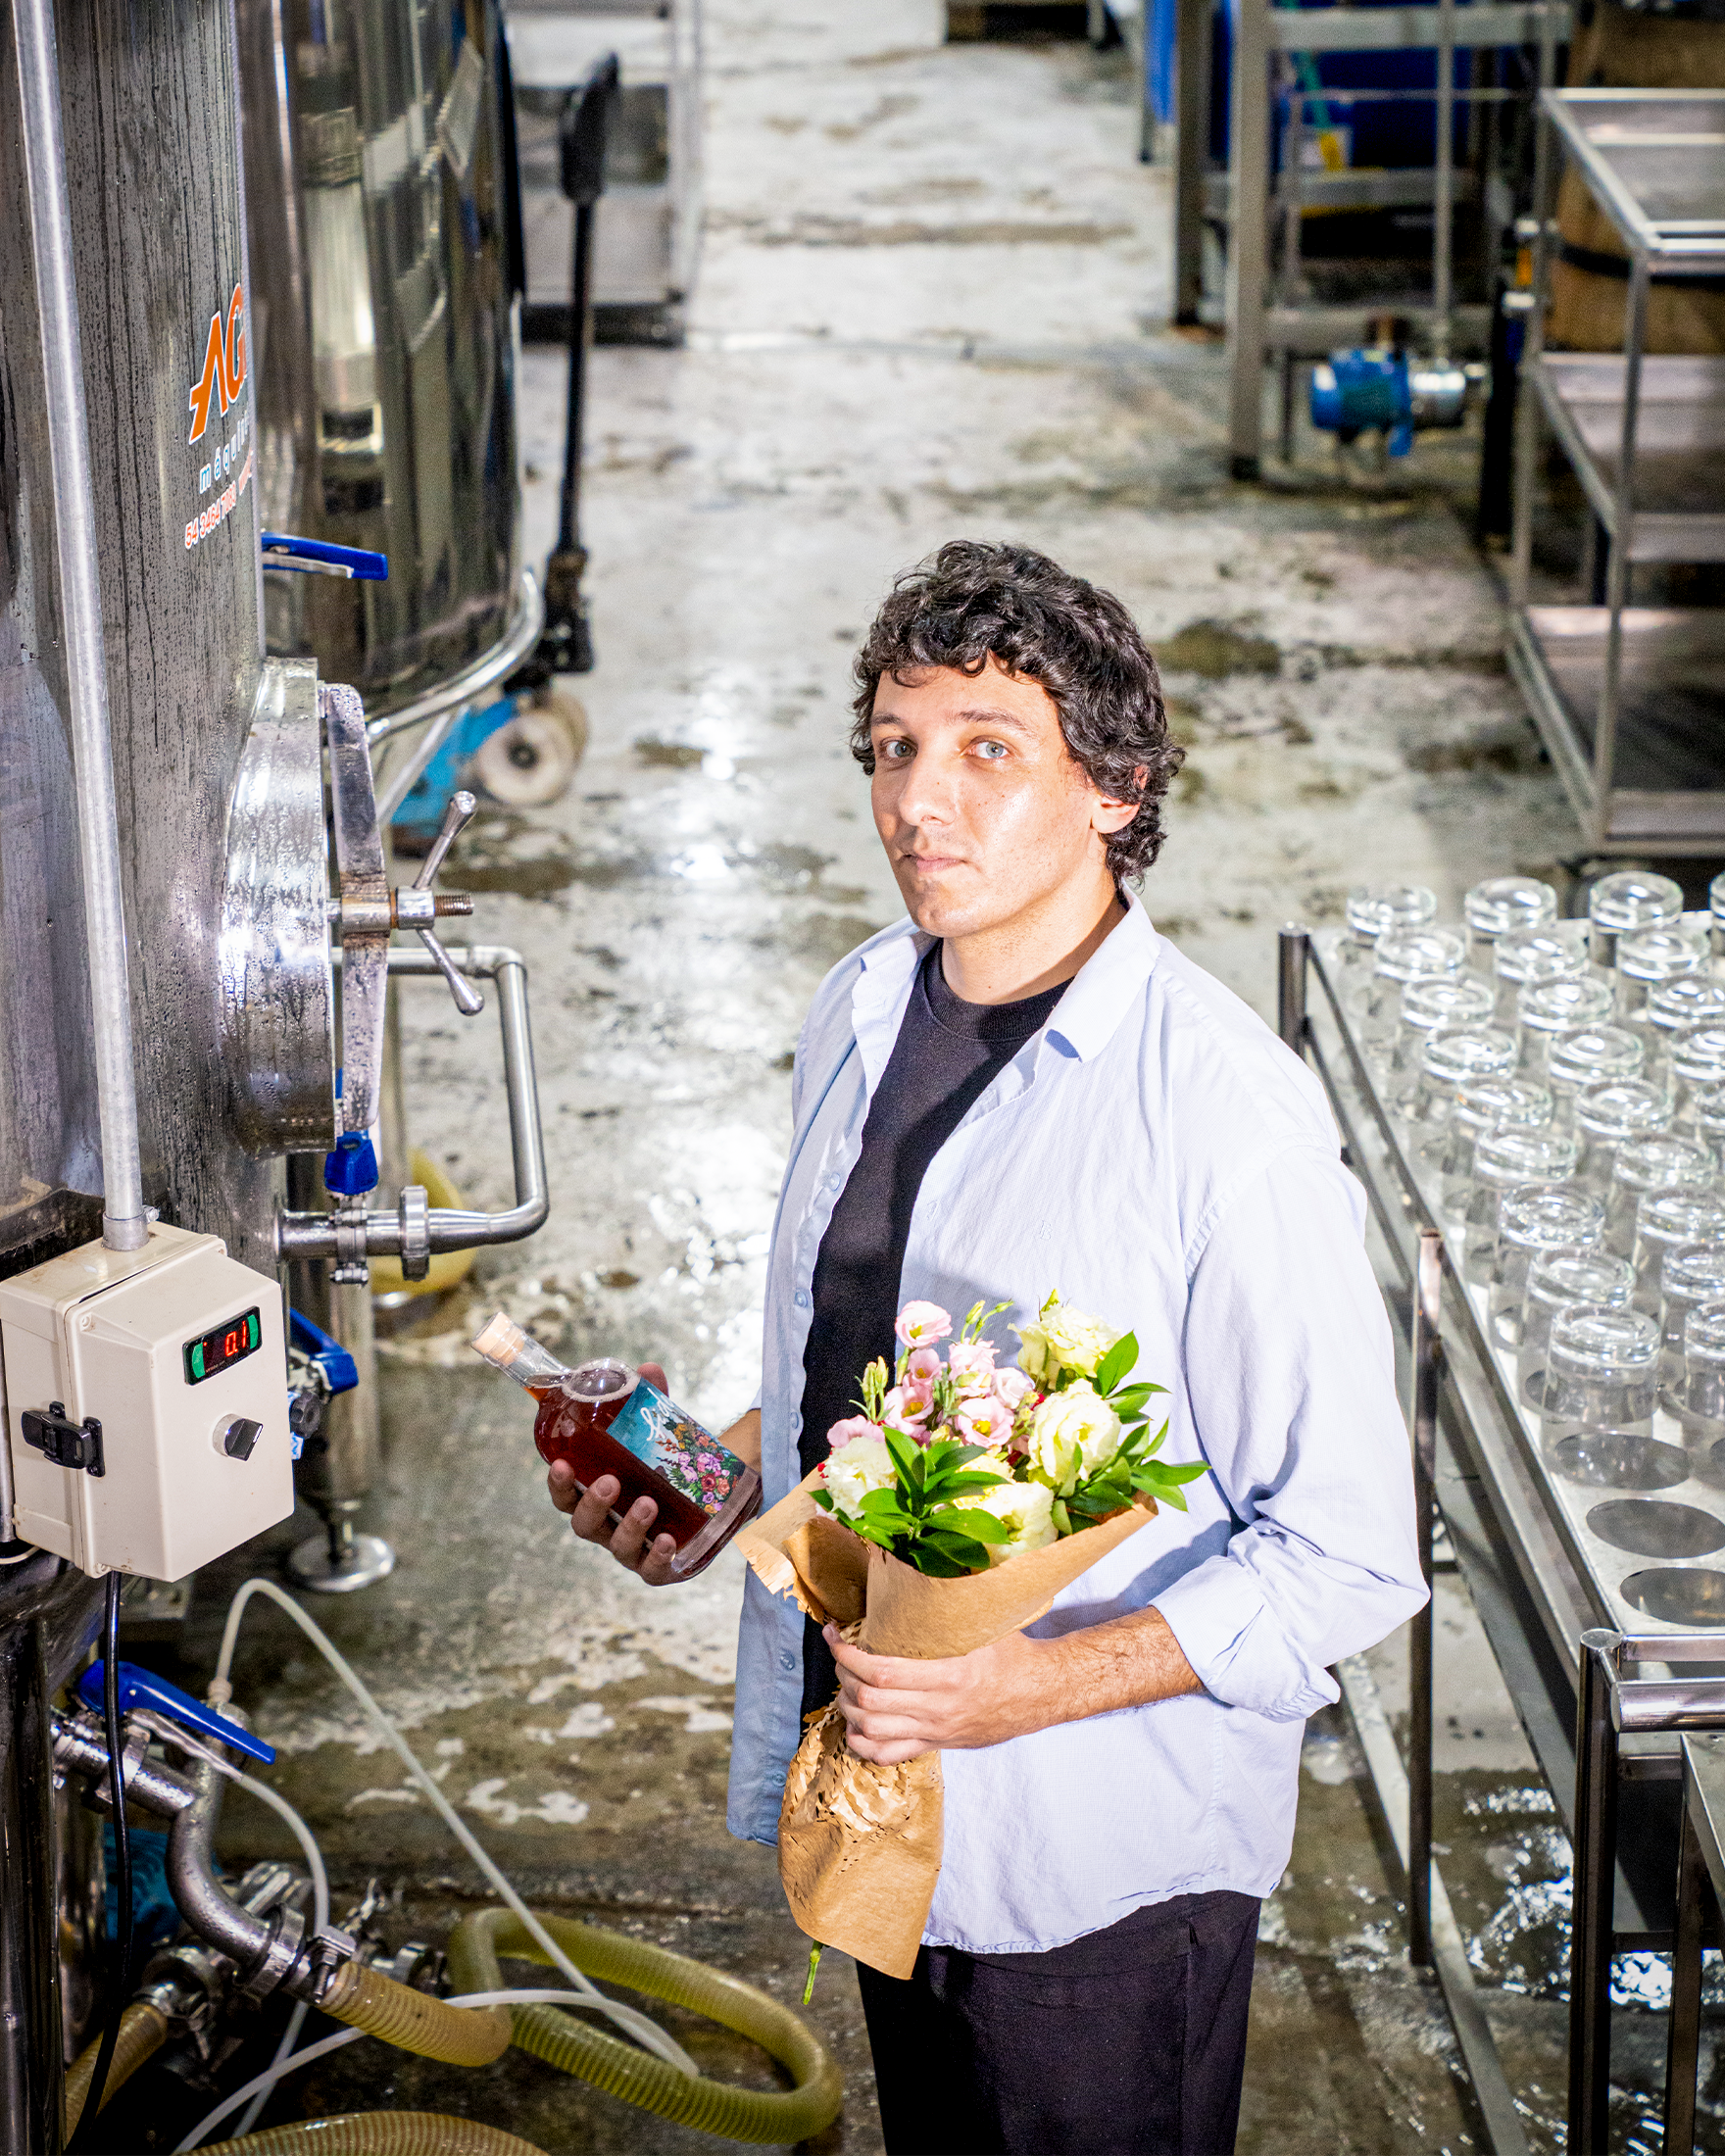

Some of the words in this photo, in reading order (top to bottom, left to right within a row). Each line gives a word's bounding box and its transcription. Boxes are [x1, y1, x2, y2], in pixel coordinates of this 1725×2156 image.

[184, 516, 199, 549] 54
[199, 498, 221, 539] 3464
[225, 1320, 247, 1357] 0.1
